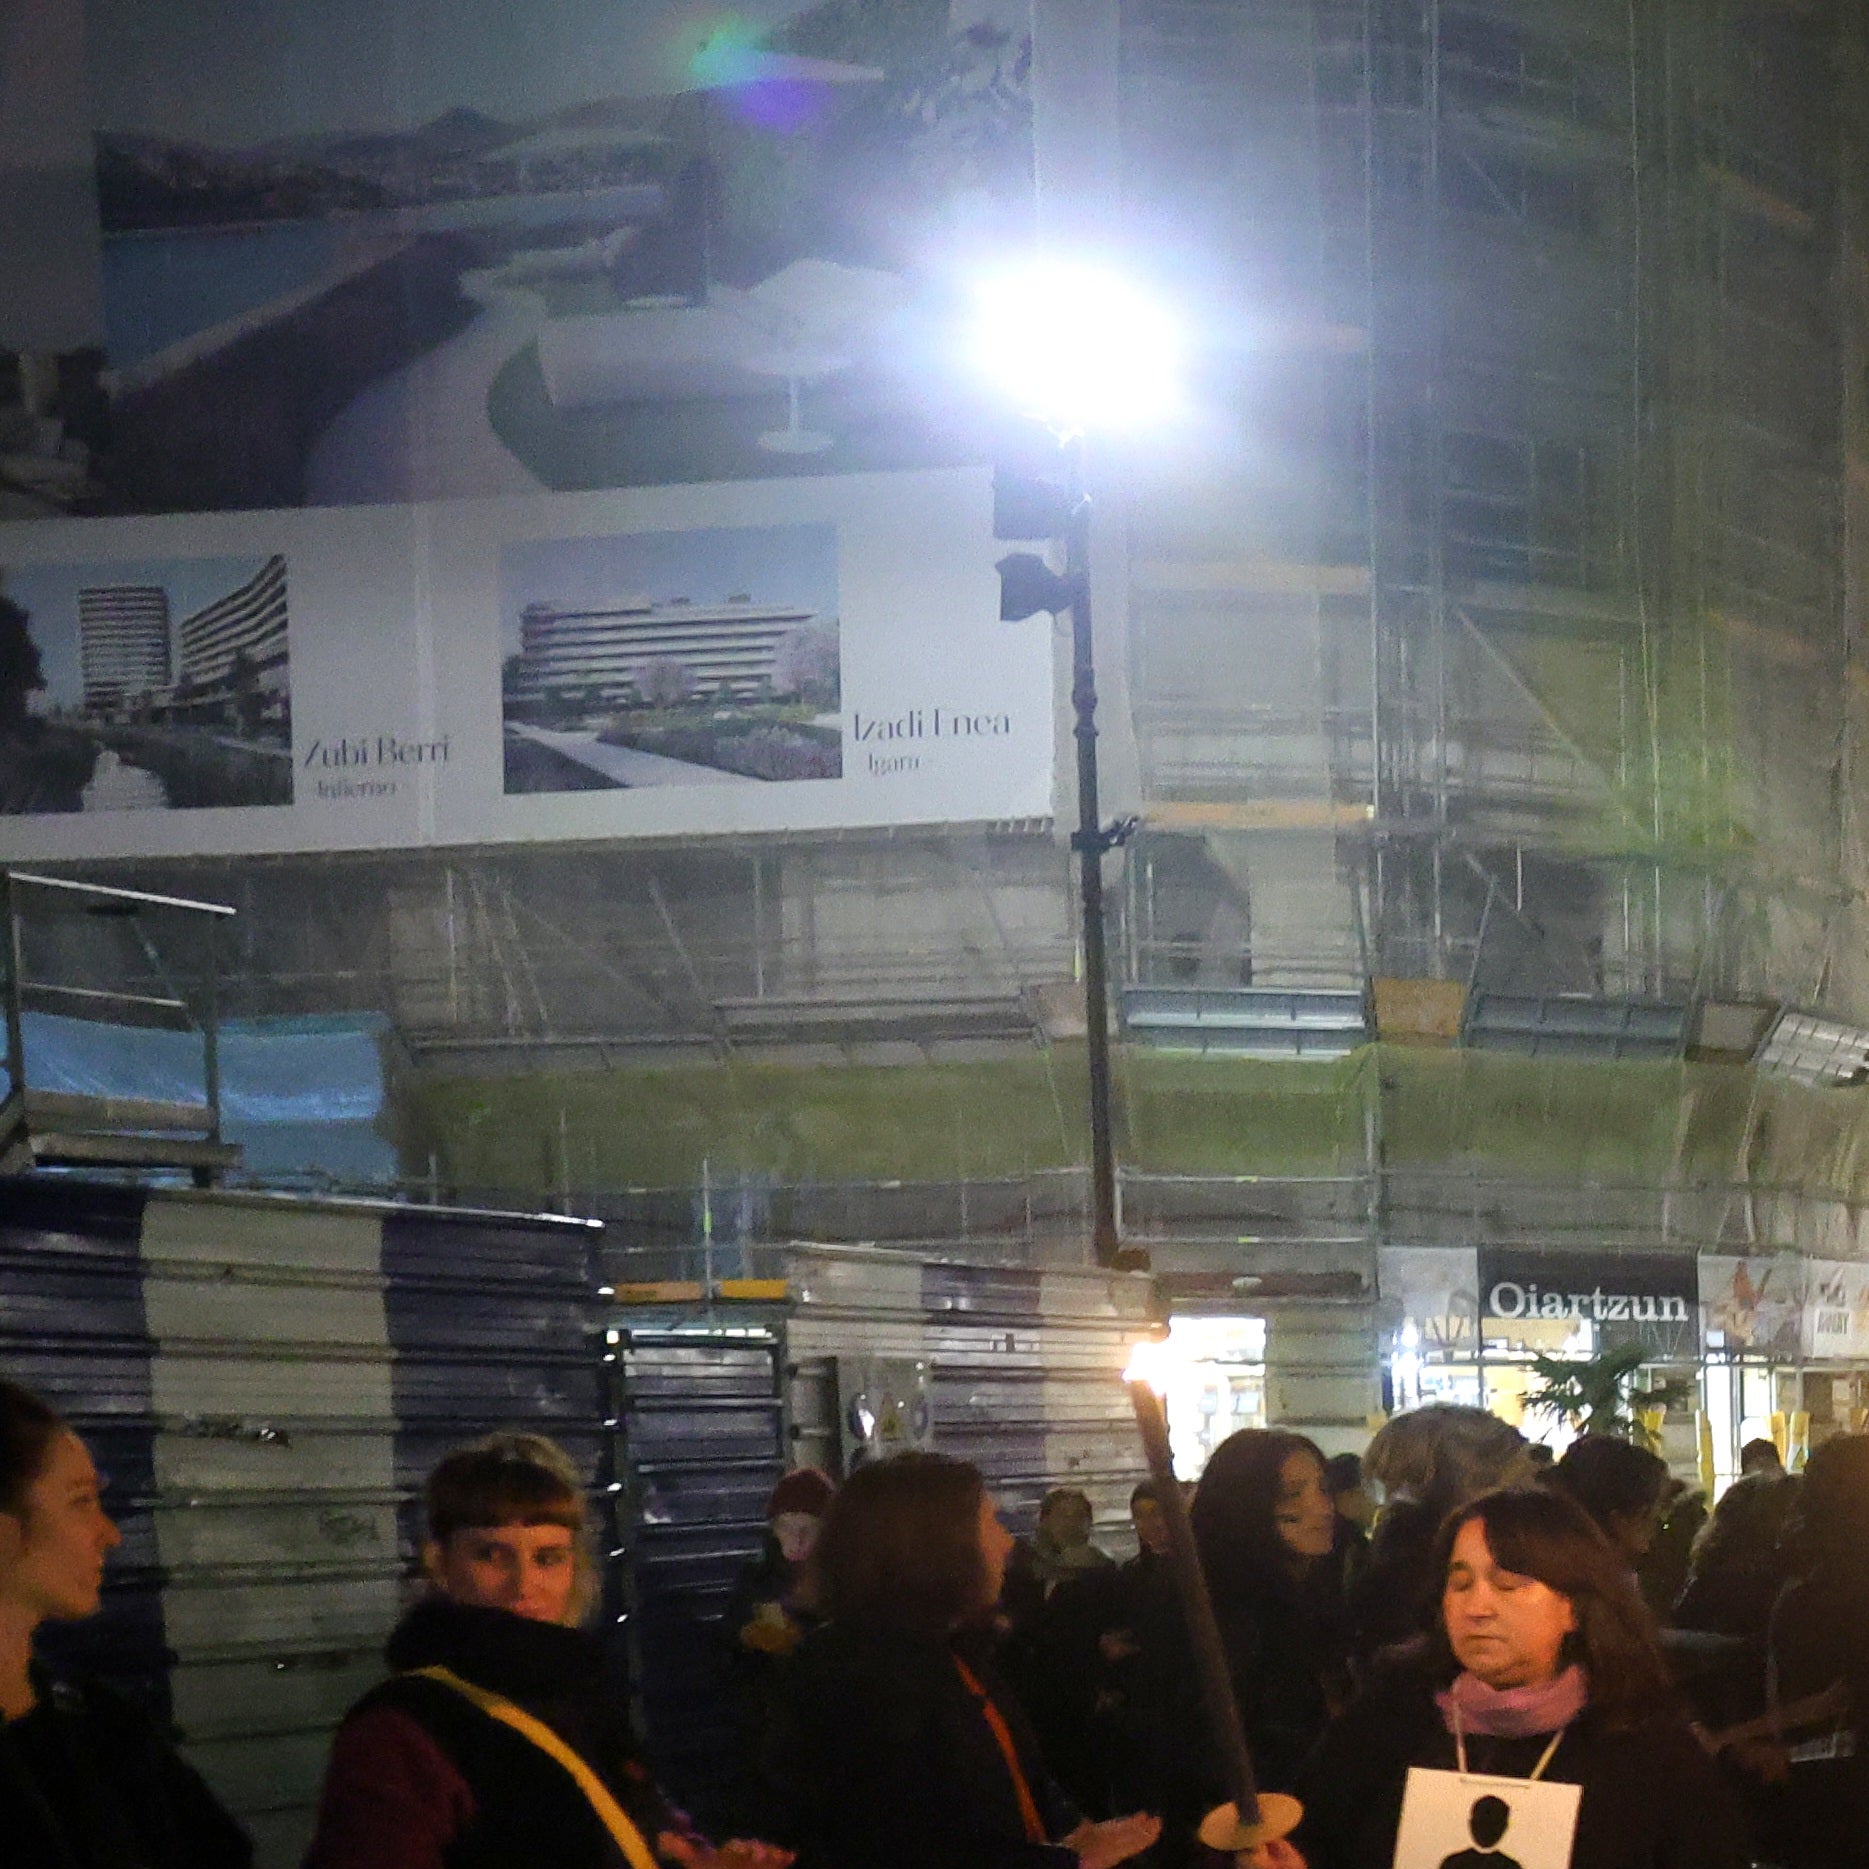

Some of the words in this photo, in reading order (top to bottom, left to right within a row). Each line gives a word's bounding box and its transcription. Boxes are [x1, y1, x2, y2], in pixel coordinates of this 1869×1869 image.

[854, 709, 923, 742] Izadi
[933, 708, 1011, 737] Enea
[304, 737, 368, 768] Zubi
[377, 734, 450, 765] Berri
[1489, 1281, 1690, 1322] Oiartzun
